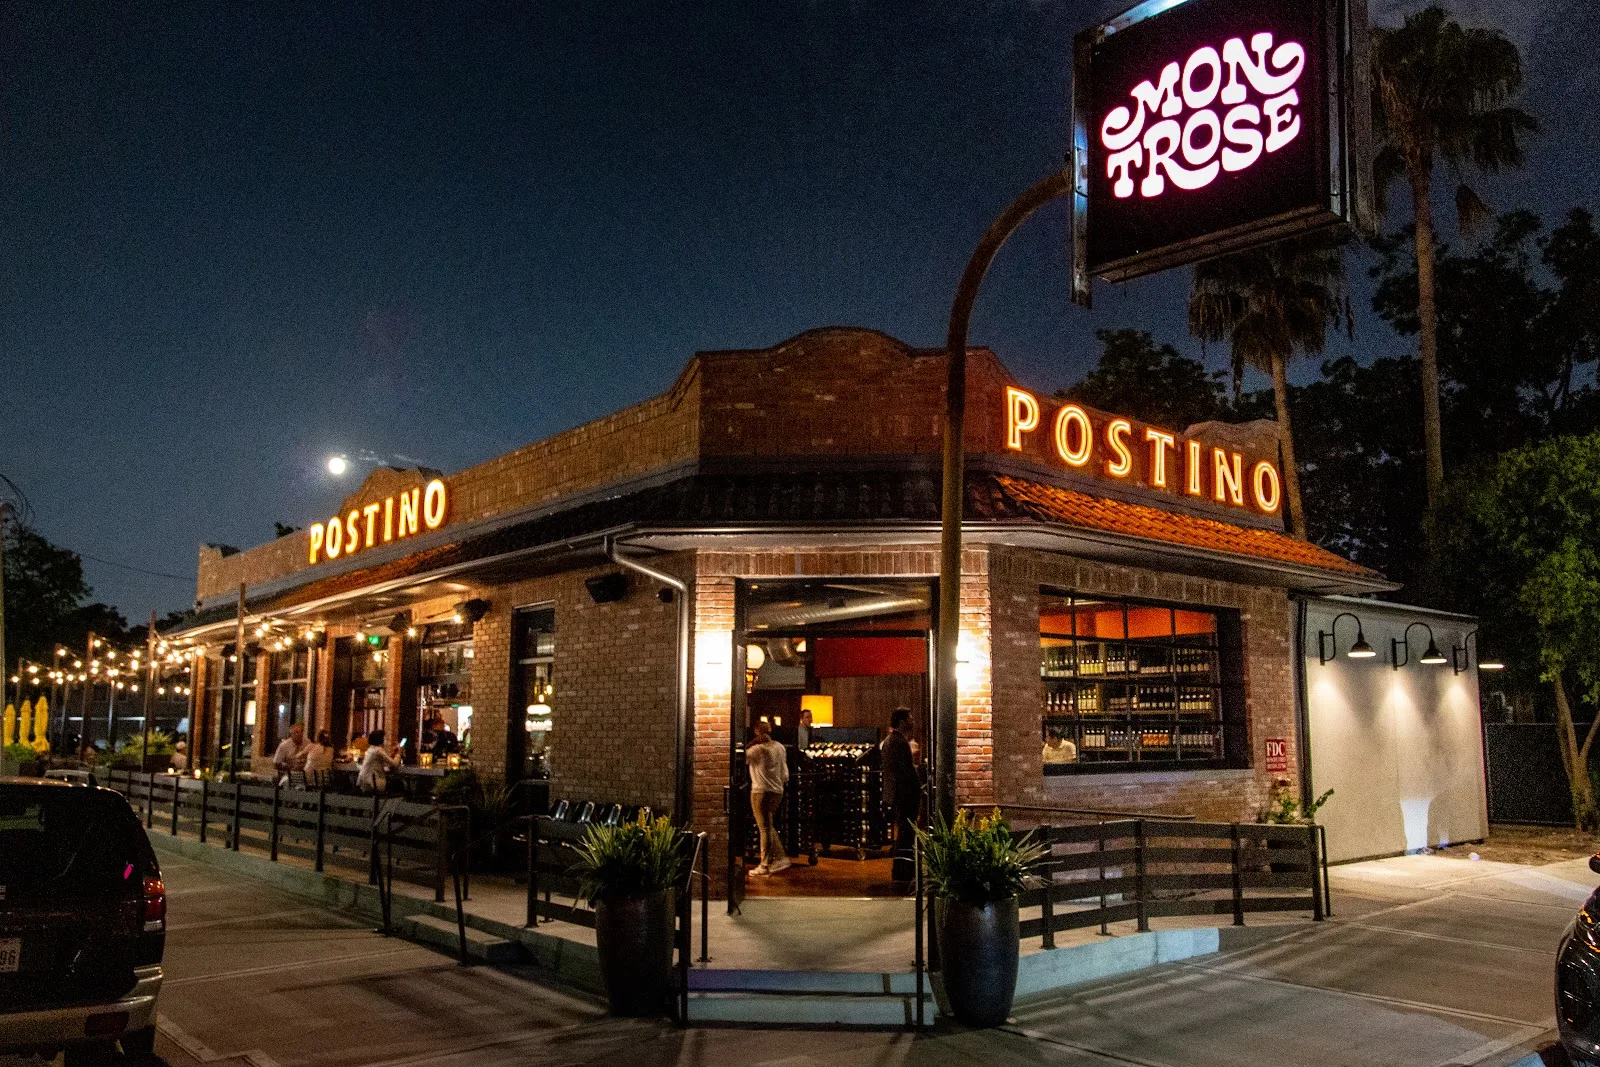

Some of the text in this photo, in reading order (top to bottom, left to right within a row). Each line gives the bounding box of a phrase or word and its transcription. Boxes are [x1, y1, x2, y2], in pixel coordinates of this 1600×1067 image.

[1102, 32, 1304, 150] MON
[1107, 89, 1300, 198] TROSE
[1006, 386, 1280, 513] POSTINO
[309, 479, 446, 564] POSTINO
[1266, 741, 1286, 757] FDC
